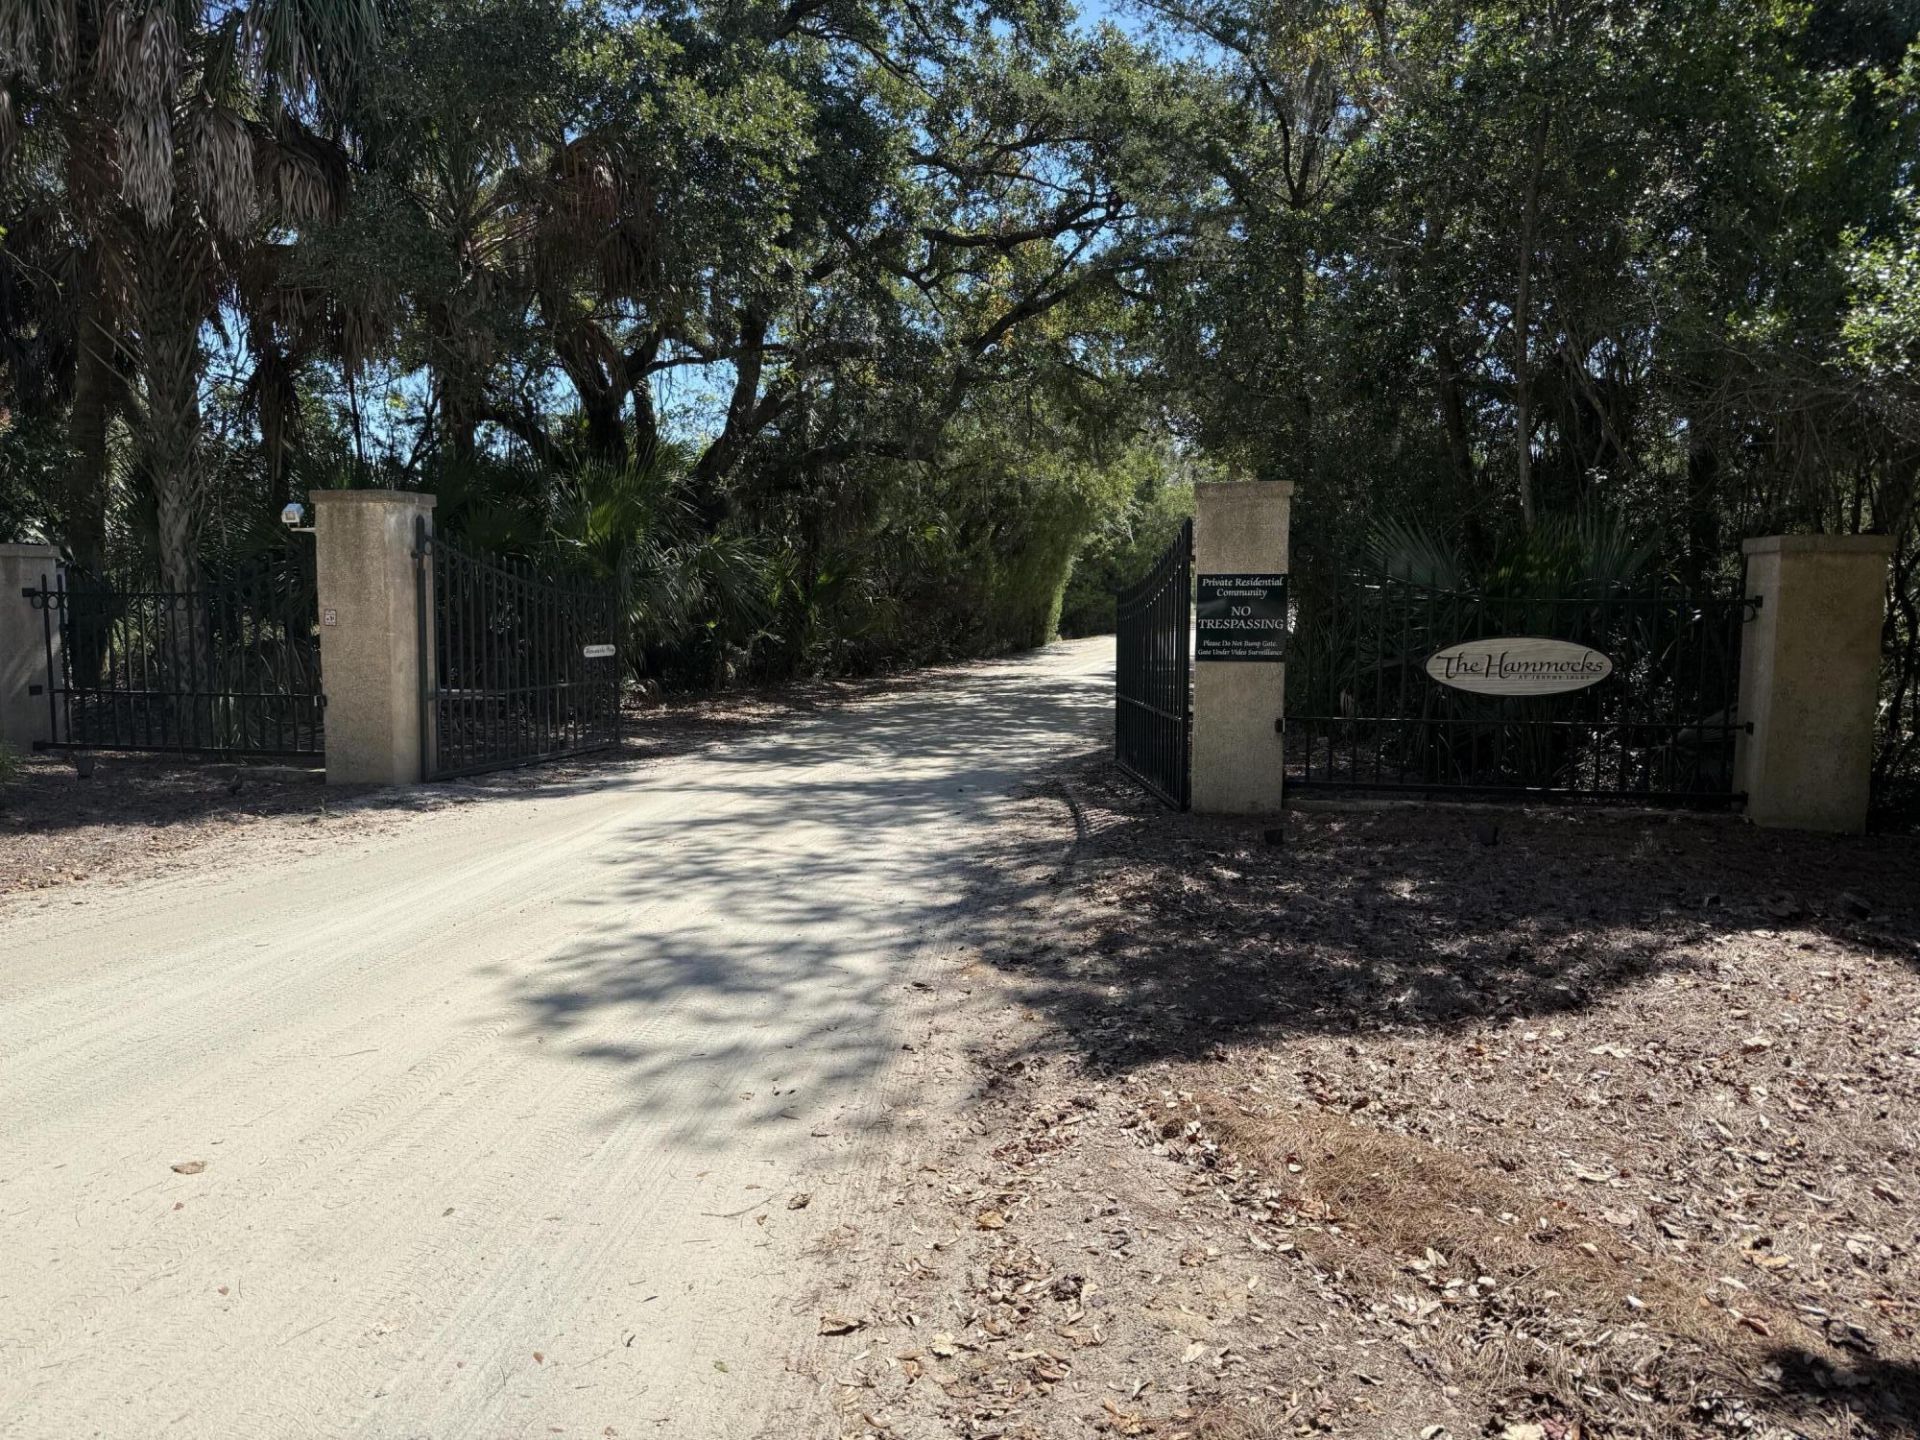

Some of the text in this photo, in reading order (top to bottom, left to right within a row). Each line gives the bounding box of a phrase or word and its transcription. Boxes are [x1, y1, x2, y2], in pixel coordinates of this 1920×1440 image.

[1202, 576, 1284, 587] Private Residential
[1216, 588, 1268, 600] Community
[1231, 606, 1252, 616] NO
[1198, 618, 1284, 630] TRESPASSING
[1436, 650, 1604, 680] The Hammocks
